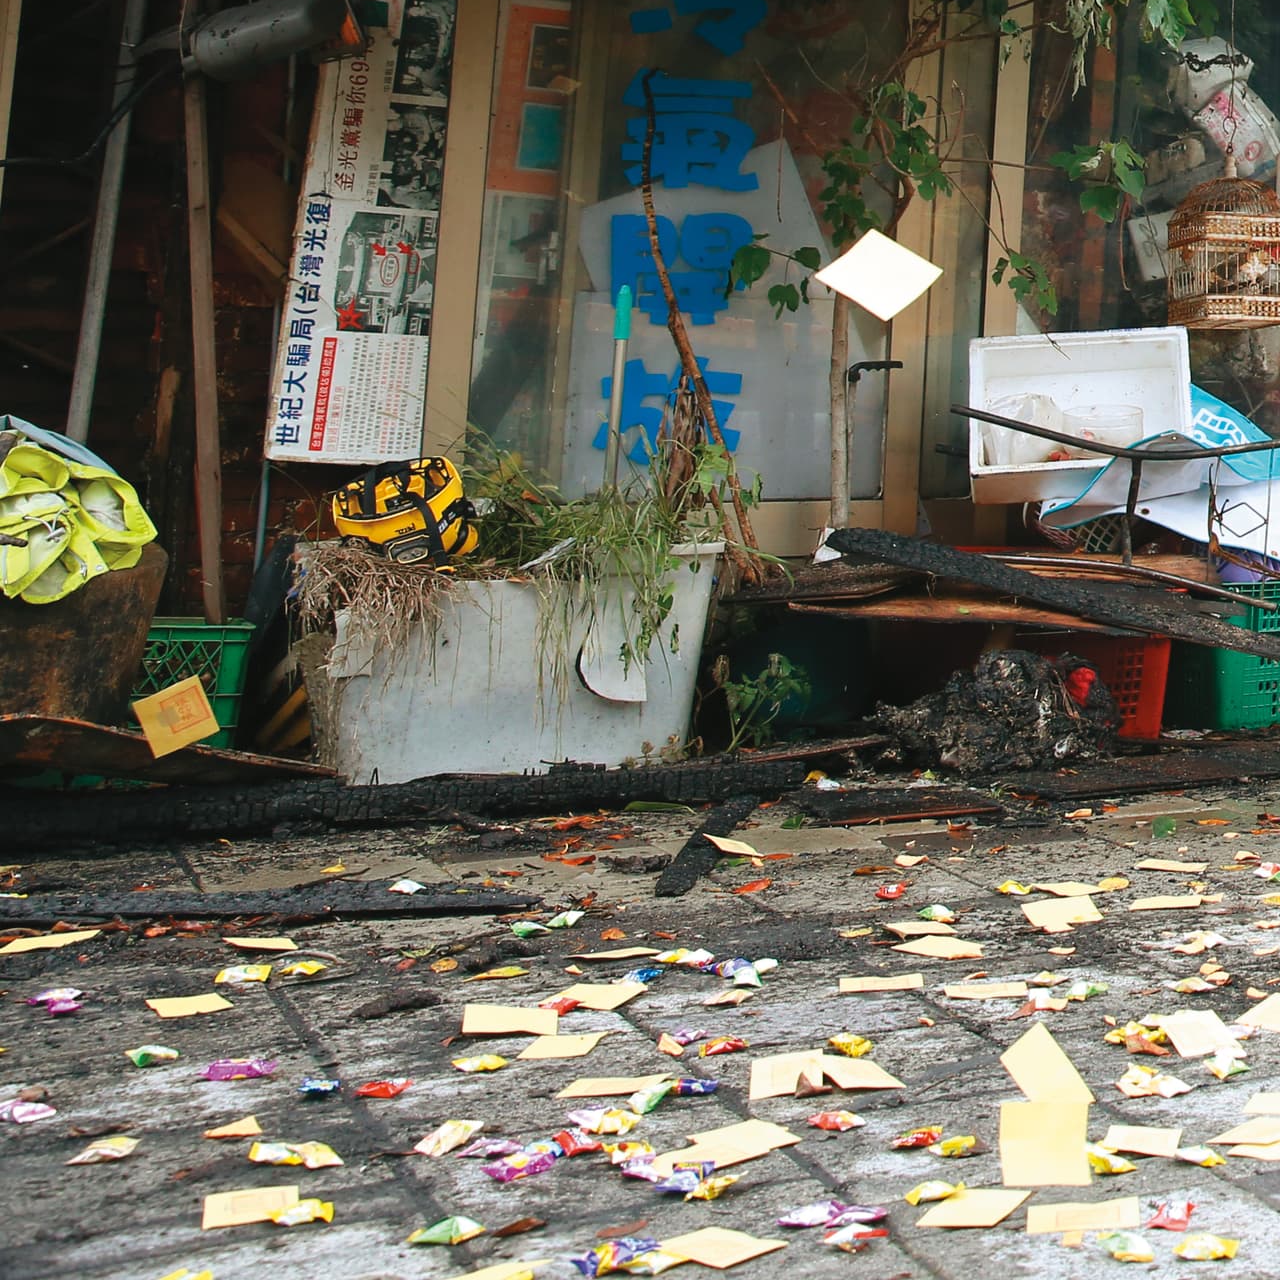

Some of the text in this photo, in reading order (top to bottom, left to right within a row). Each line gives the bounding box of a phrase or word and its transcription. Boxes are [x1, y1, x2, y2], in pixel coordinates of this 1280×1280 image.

[334, 33, 377, 194] 金光黨騙你69
[274, 191, 333, 447] 世紀大騙局(台灣光復)
